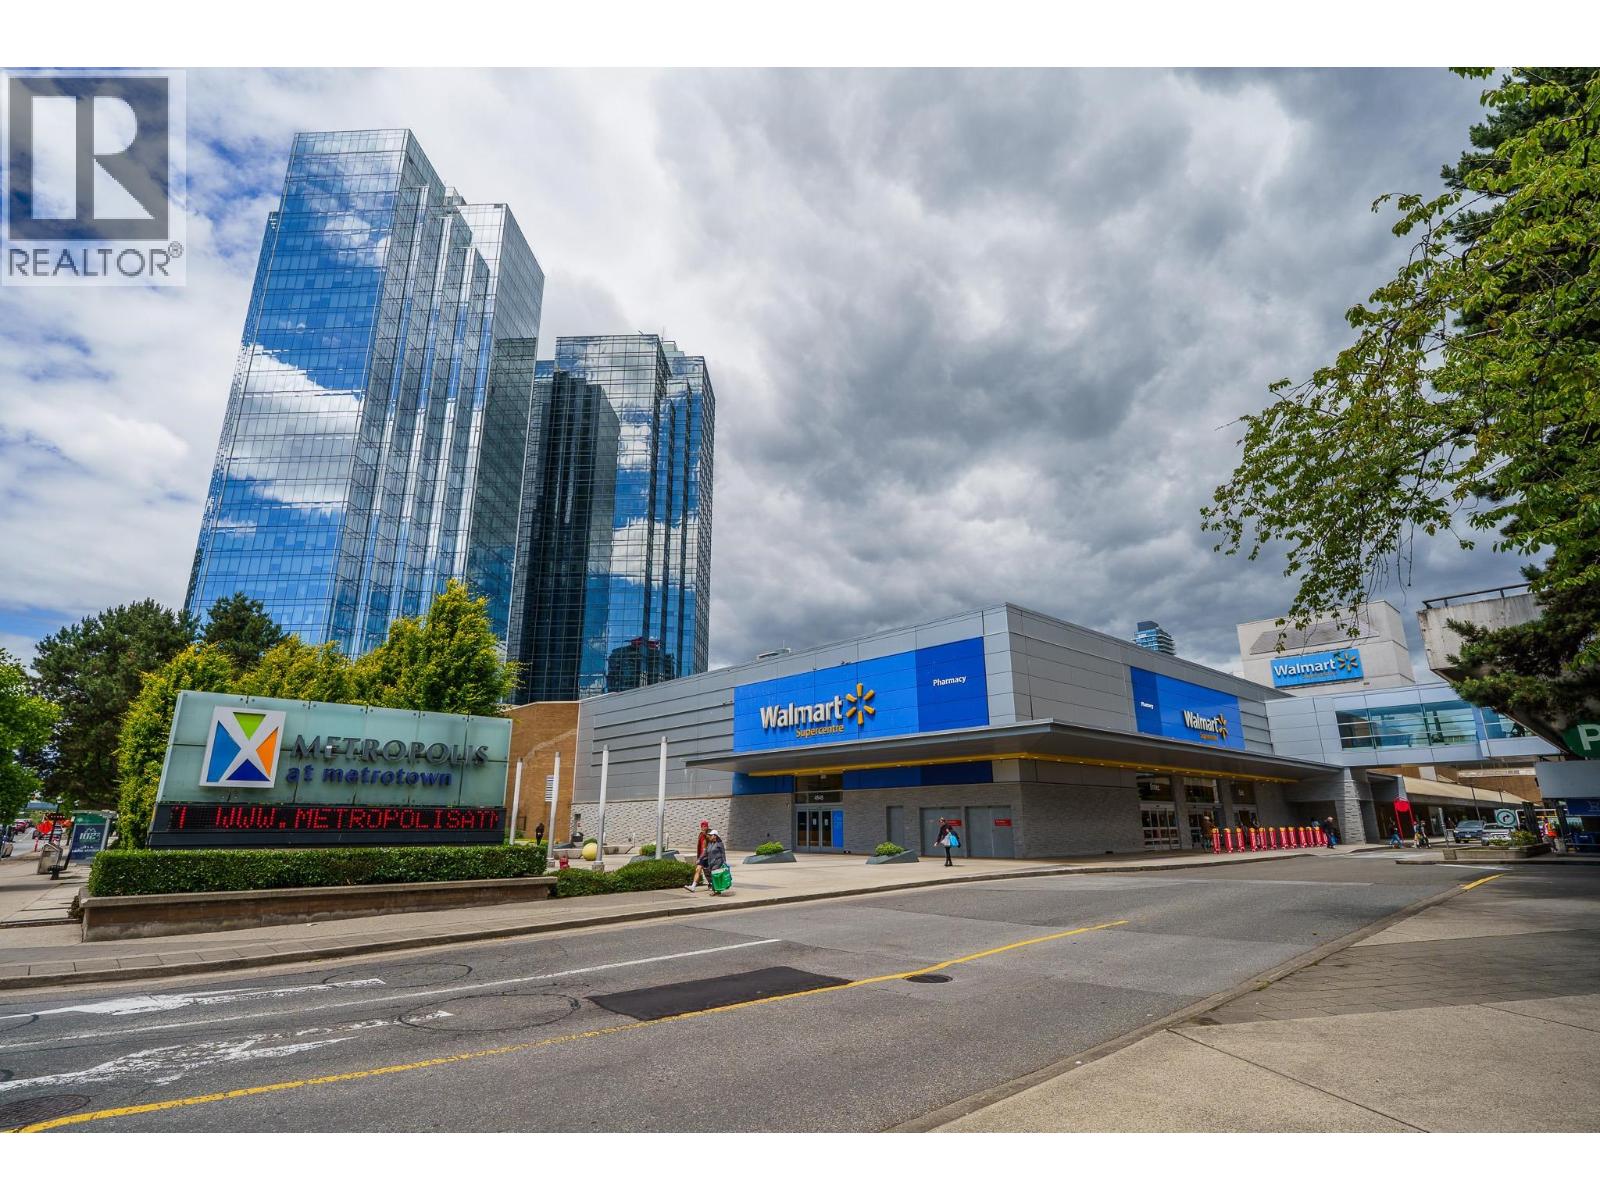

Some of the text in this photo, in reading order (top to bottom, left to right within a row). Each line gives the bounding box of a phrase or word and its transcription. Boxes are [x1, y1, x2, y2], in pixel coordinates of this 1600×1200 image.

[1274, 659, 1337, 676] Walmart
[932, 676, 967, 687] Pharmacy
[760, 695, 843, 729] Walmart
[1183, 710, 1220, 733] Walmart
[795, 724, 845, 738] Supercentre
[1577, 724, 1600, 750] P
[290, 734, 489, 767] METROPOLIS
[286, 764, 453, 786] at metrotown
